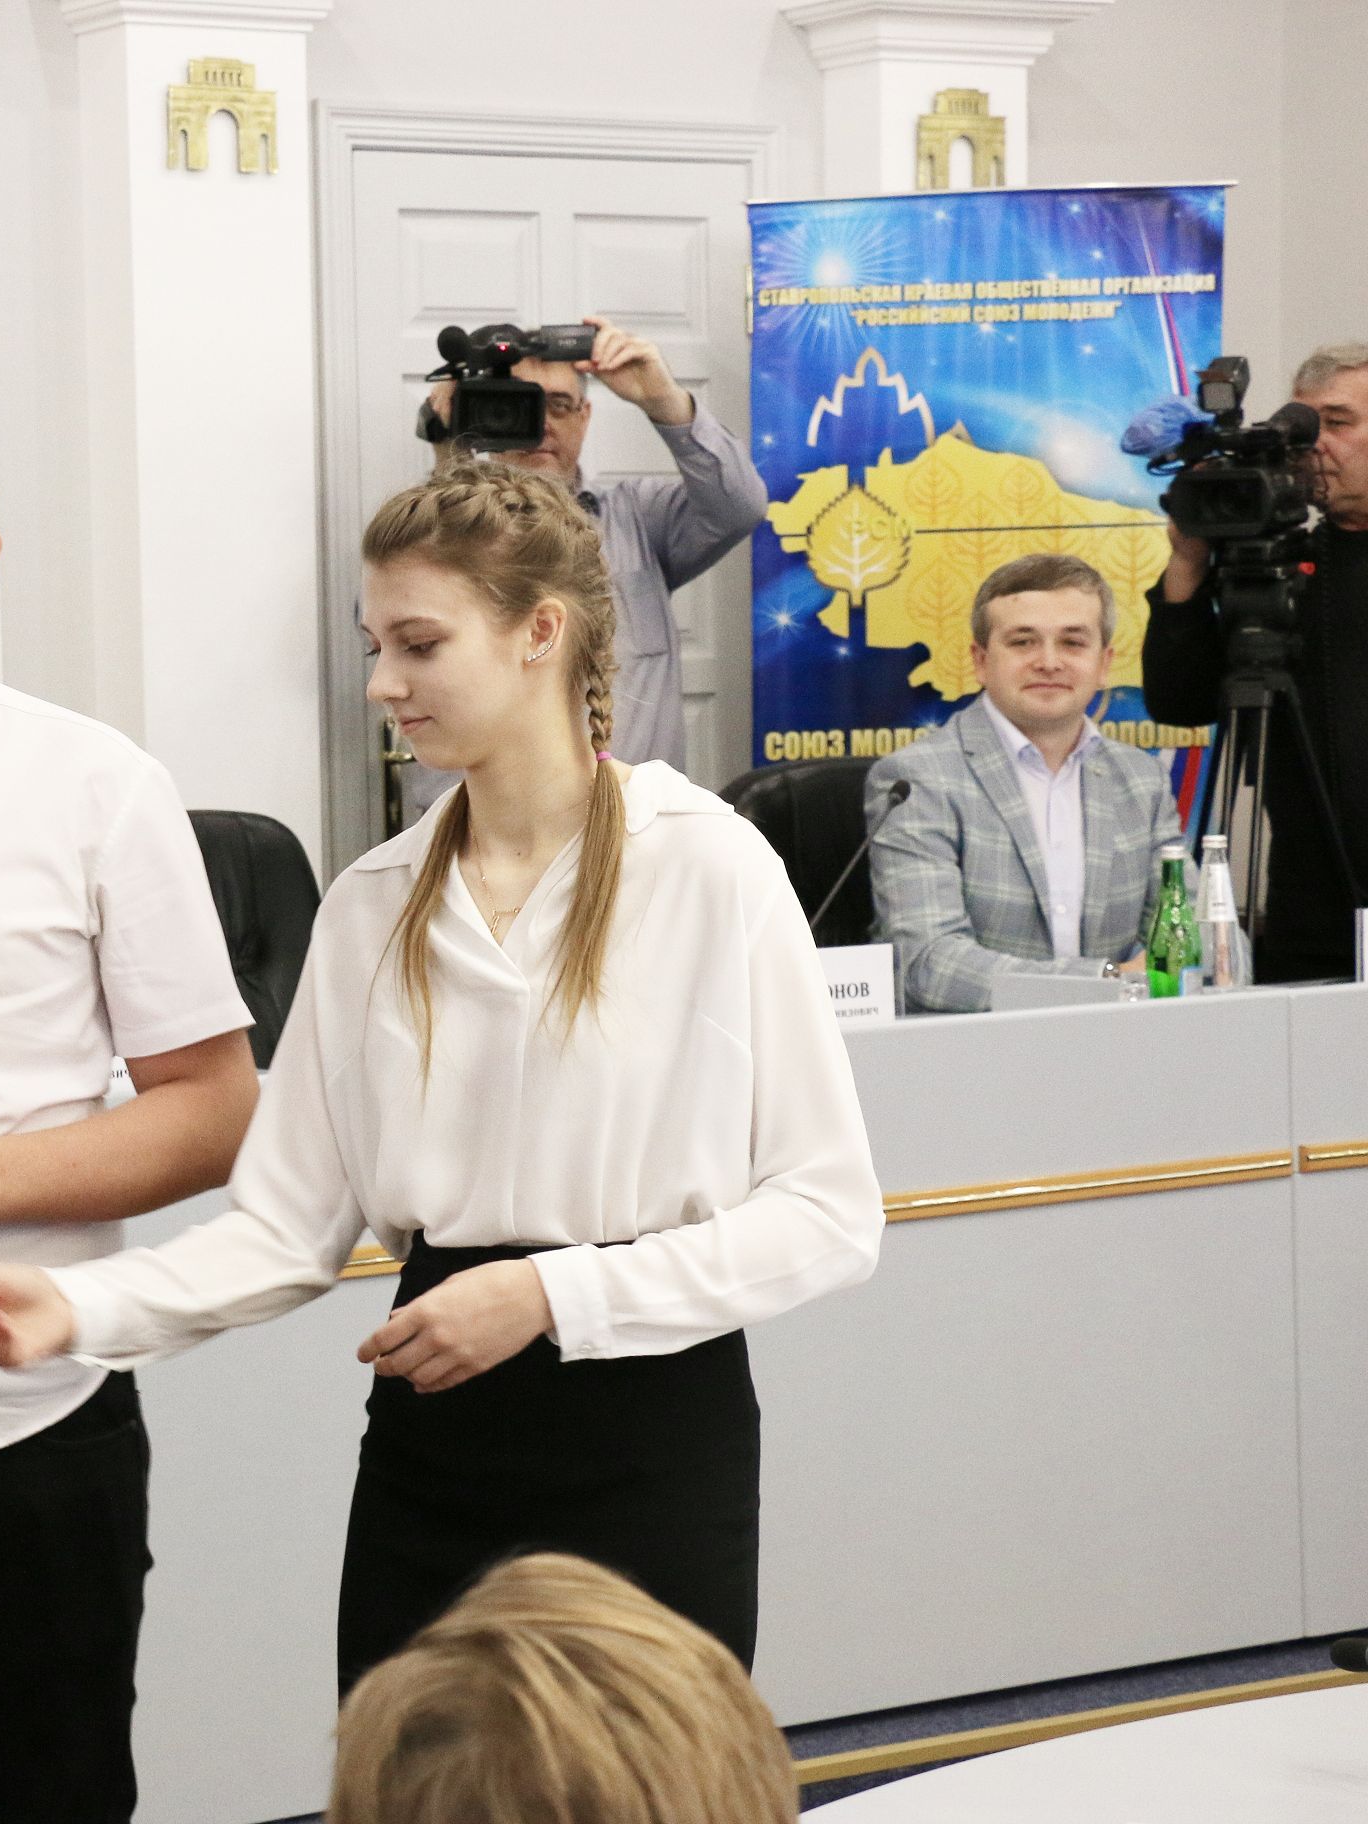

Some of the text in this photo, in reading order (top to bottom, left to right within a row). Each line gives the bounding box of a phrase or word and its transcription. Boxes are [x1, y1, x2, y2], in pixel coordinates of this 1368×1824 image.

[758, 273, 1216, 306] СТАВРОПОЛЬСКАЯ КРАЕВАЯ ОБЩЕСТВЕННАЯ ОРГАНИЗАЦИЯ
[973, 304, 1020, 323] СОЮЗ
[764, 729, 845, 761] СОЮЗ
